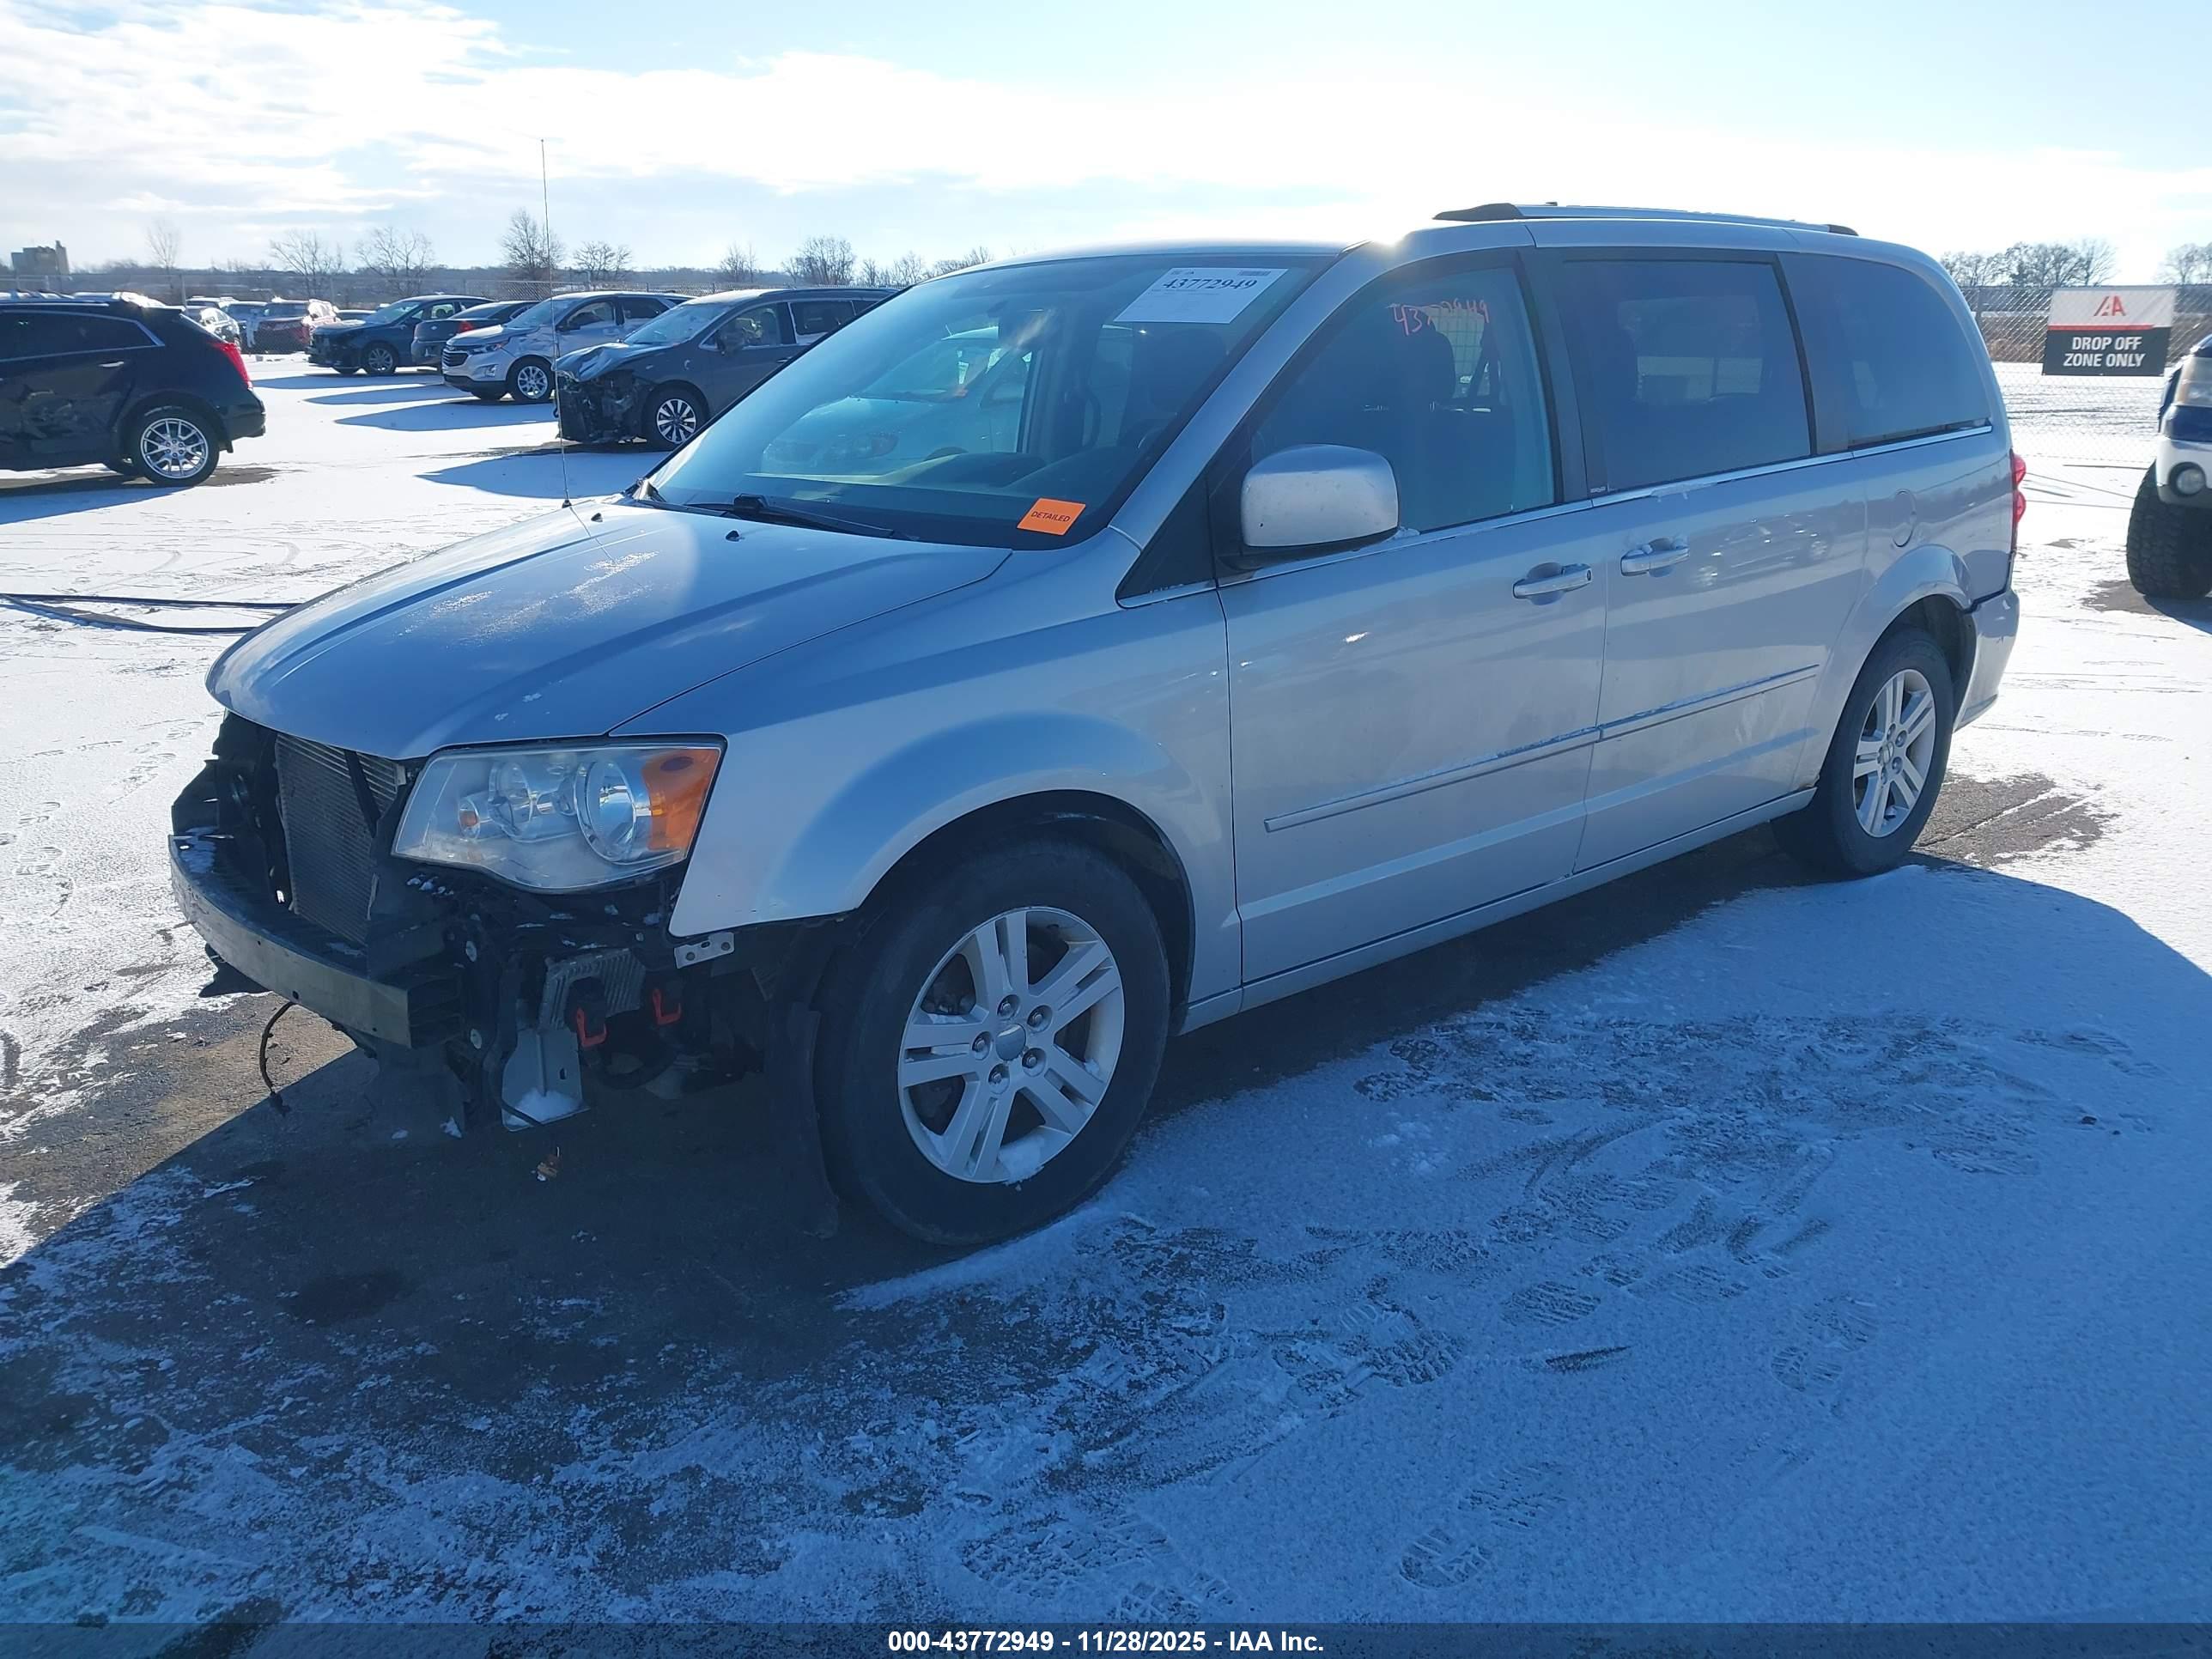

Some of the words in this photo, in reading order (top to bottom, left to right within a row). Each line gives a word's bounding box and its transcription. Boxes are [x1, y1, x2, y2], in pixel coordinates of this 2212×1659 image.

[1163, 278, 1258, 289] 43772949
[2072, 337, 2112, 350] DROP
[2115, 337, 2142, 350] OFF
[2063, 353, 2103, 367] ZONE
[2106, 353, 2146, 368] ONLY
[1030, 511, 1071, 522] DETAILED
